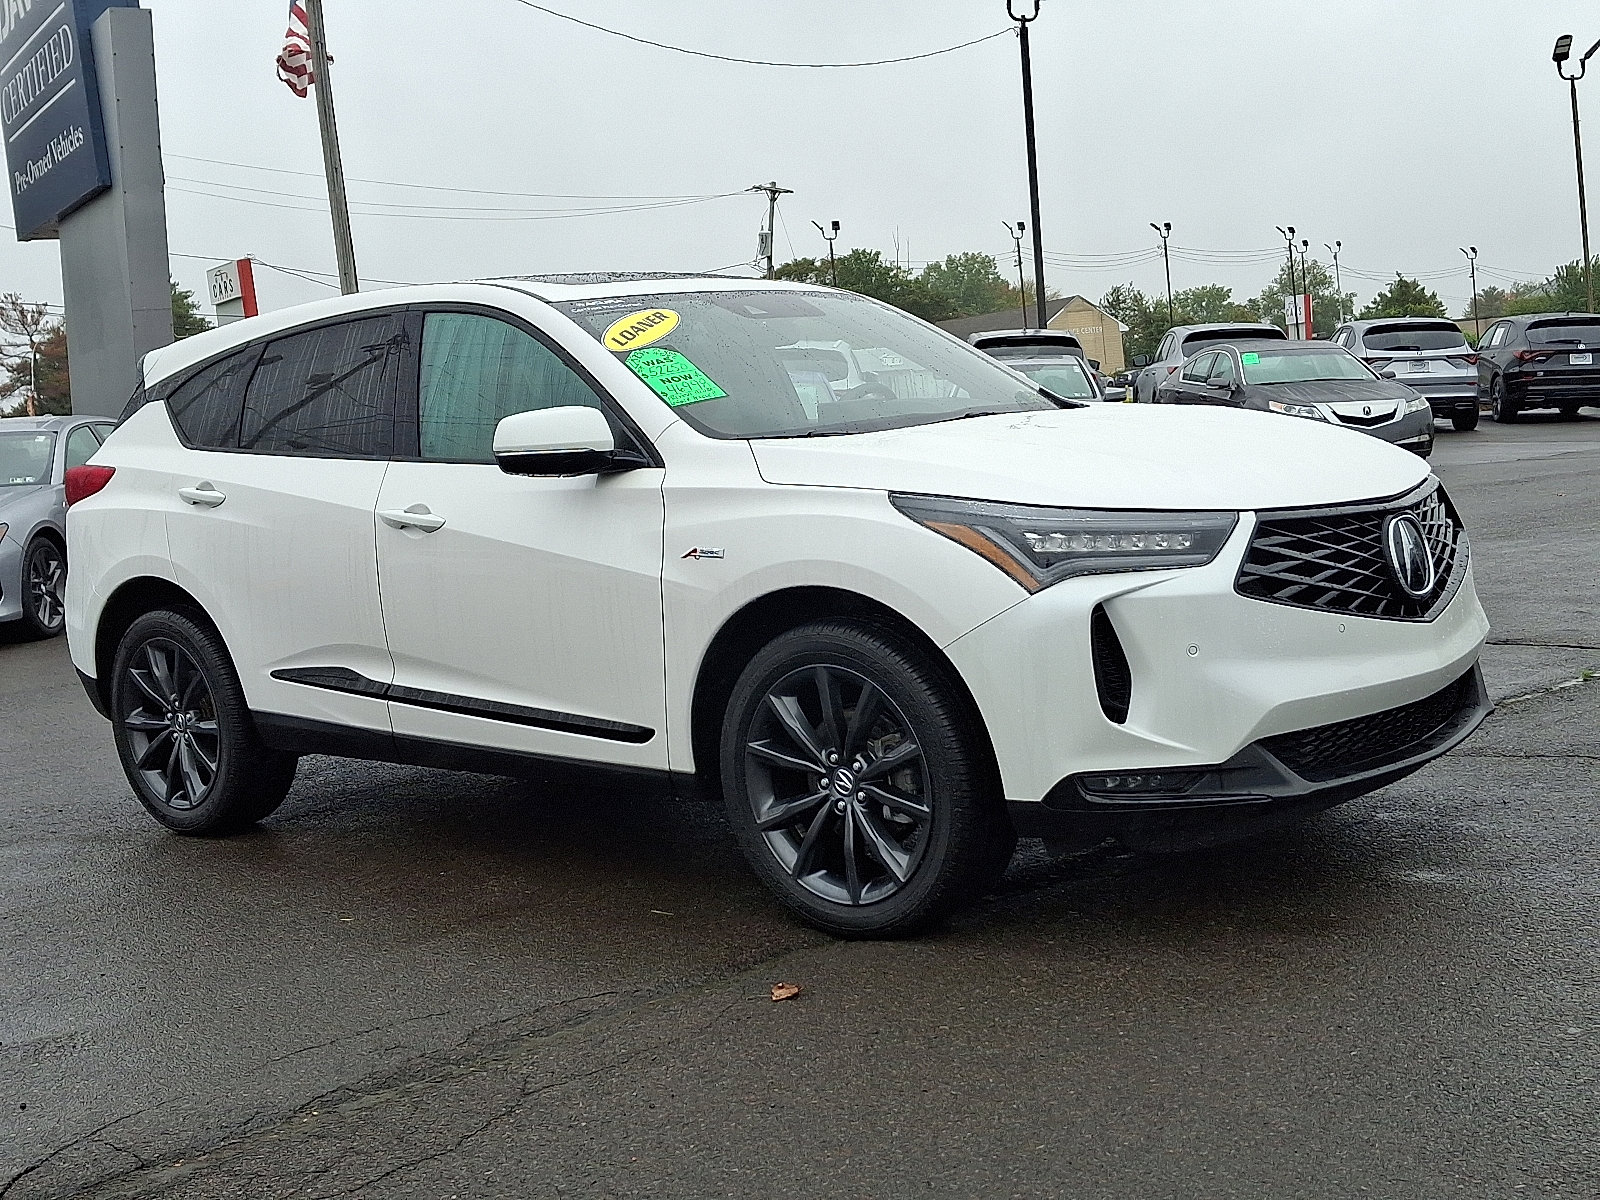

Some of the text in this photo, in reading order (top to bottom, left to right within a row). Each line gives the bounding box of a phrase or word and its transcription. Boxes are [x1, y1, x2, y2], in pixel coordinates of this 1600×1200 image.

[1, 24, 73, 125] CERTIFIED
[15, 125, 84, 195] Pre-Owned Vehicles
[213, 278, 234, 299] CARS
[1286, 307, 1302, 318] CAS
[611, 311, 671, 347] LOANER
[1080, 326, 1103, 335] CENTER
[641, 358, 674, 367] WAS
[660, 373, 693, 385] NOW
